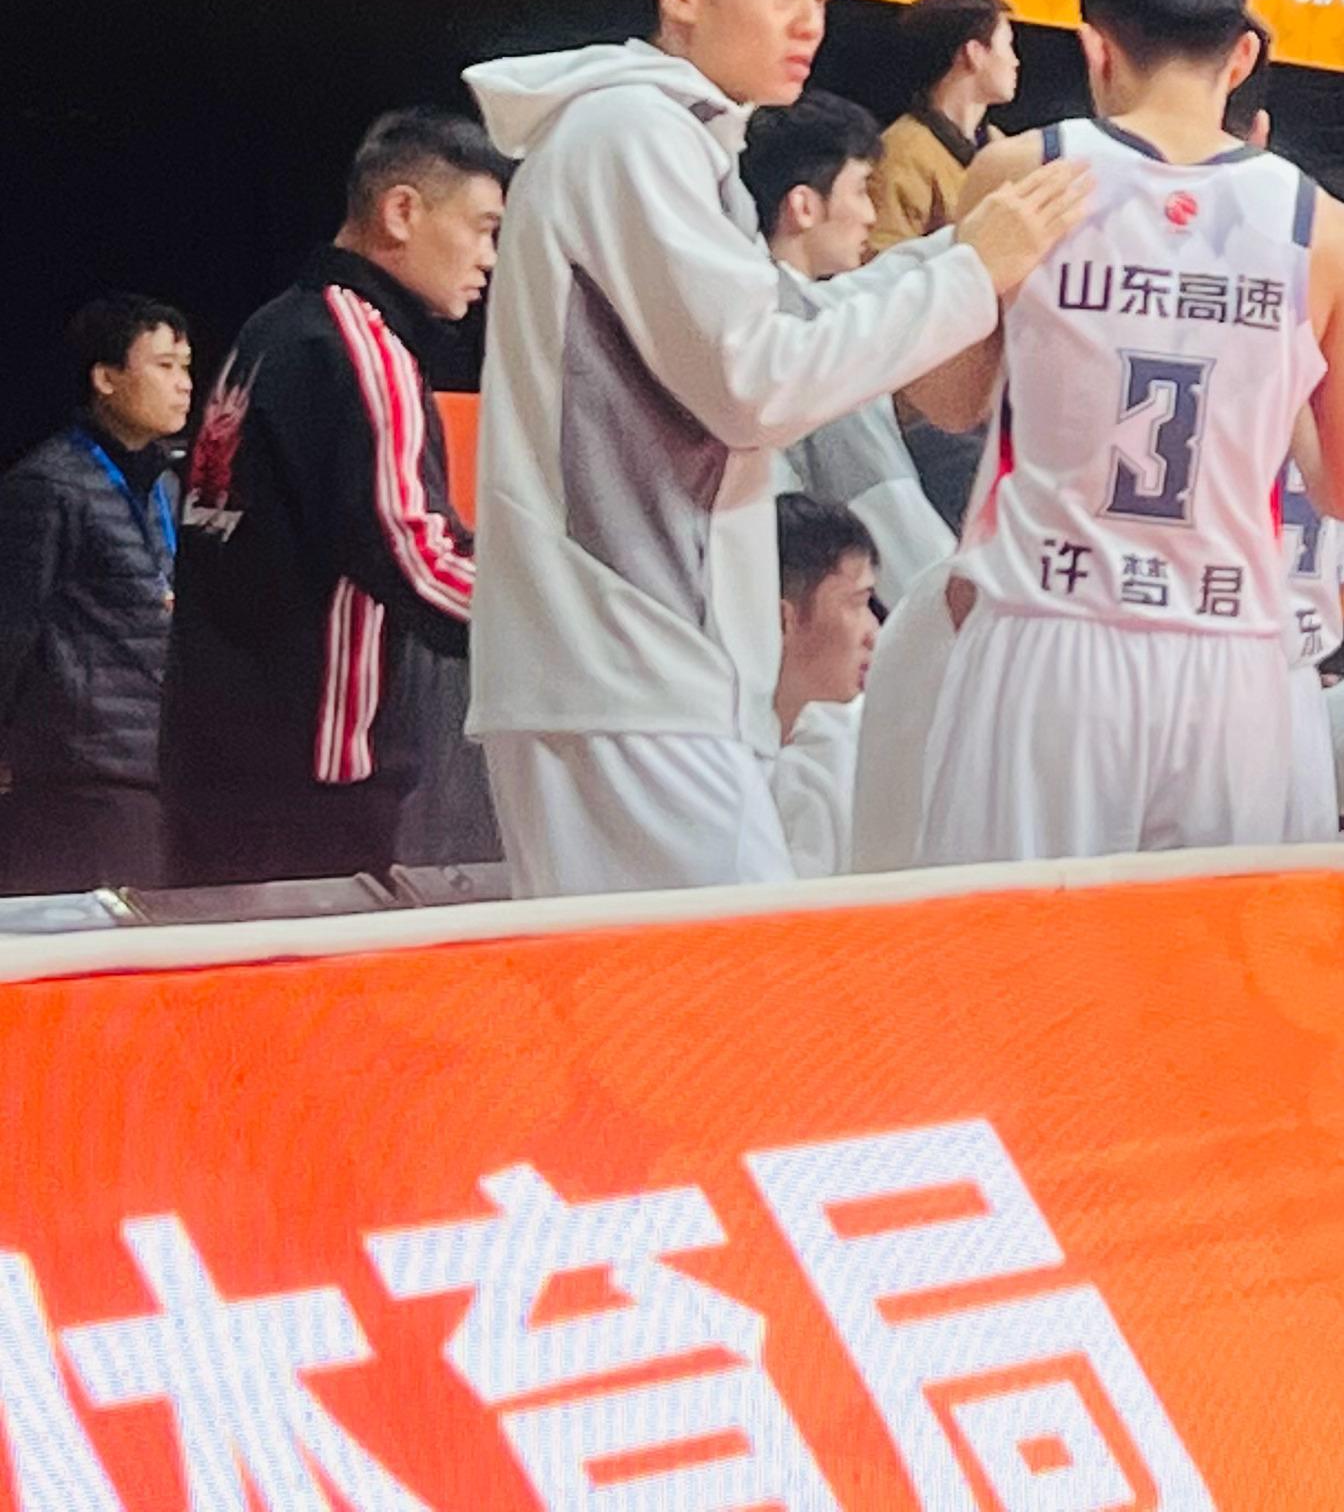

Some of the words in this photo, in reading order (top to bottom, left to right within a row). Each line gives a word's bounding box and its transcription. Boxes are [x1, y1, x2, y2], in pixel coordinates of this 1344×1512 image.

[1057, 261, 1285, 332] 山东高速
[1096, 348, 1217, 528] 3
[1041, 540, 1244, 618] 许梦君
